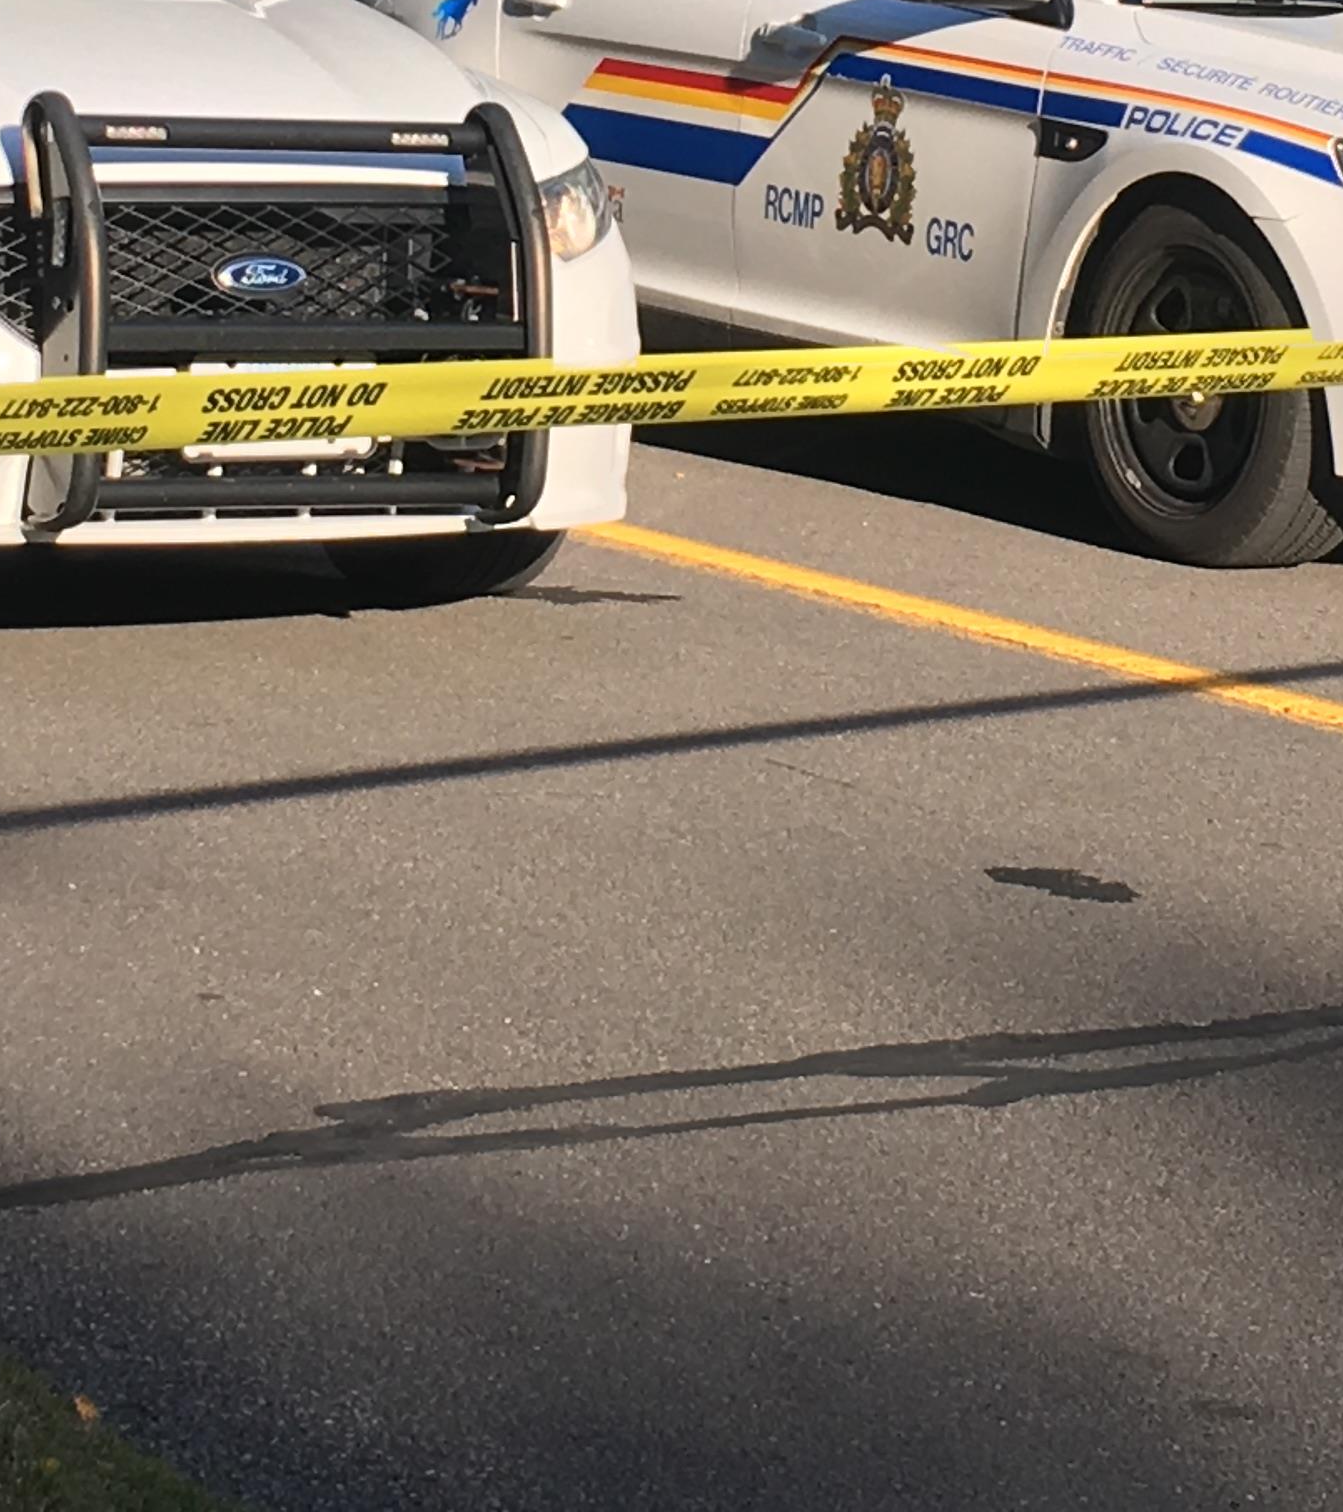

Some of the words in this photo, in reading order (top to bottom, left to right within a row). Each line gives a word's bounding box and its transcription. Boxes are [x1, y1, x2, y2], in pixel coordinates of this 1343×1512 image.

[1059, 35, 1137, 62] TRAFFIC
[1157, 56, 1259, 92] SÉCURITÉ
[1125, 105, 1243, 147] POLICE
[764, 184, 824, 229] RCMP
[926, 216, 975, 262] GRC
[961, 357, 1009, 379] NOT
[1006, 355, 1042, 376] DO
[1113, 349, 1204, 372] INTERDIT
[1200, 345, 1289, 368] PASSAGE
[586, 369, 697, 396] PASSAGE
[891, 359, 965, 383] CROSS
[289, 384, 349, 409] NOT
[347, 382, 388, 407] DO
[480, 373, 591, 400] INTERDIT
[883, 387, 938, 408] LINE
[933, 385, 1012, 405] POLICE
[1085, 377, 1163, 398] POLICE
[201, 386, 292, 414] CROSS
[572, 400, 686, 423] BARRAGE
[258, 415, 354, 440] POLICE
[451, 406, 542, 431] POLICE
[537, 405, 577, 426] DE
[80, 426, 149, 446] CRIME
[196, 419, 261, 442] LINE
